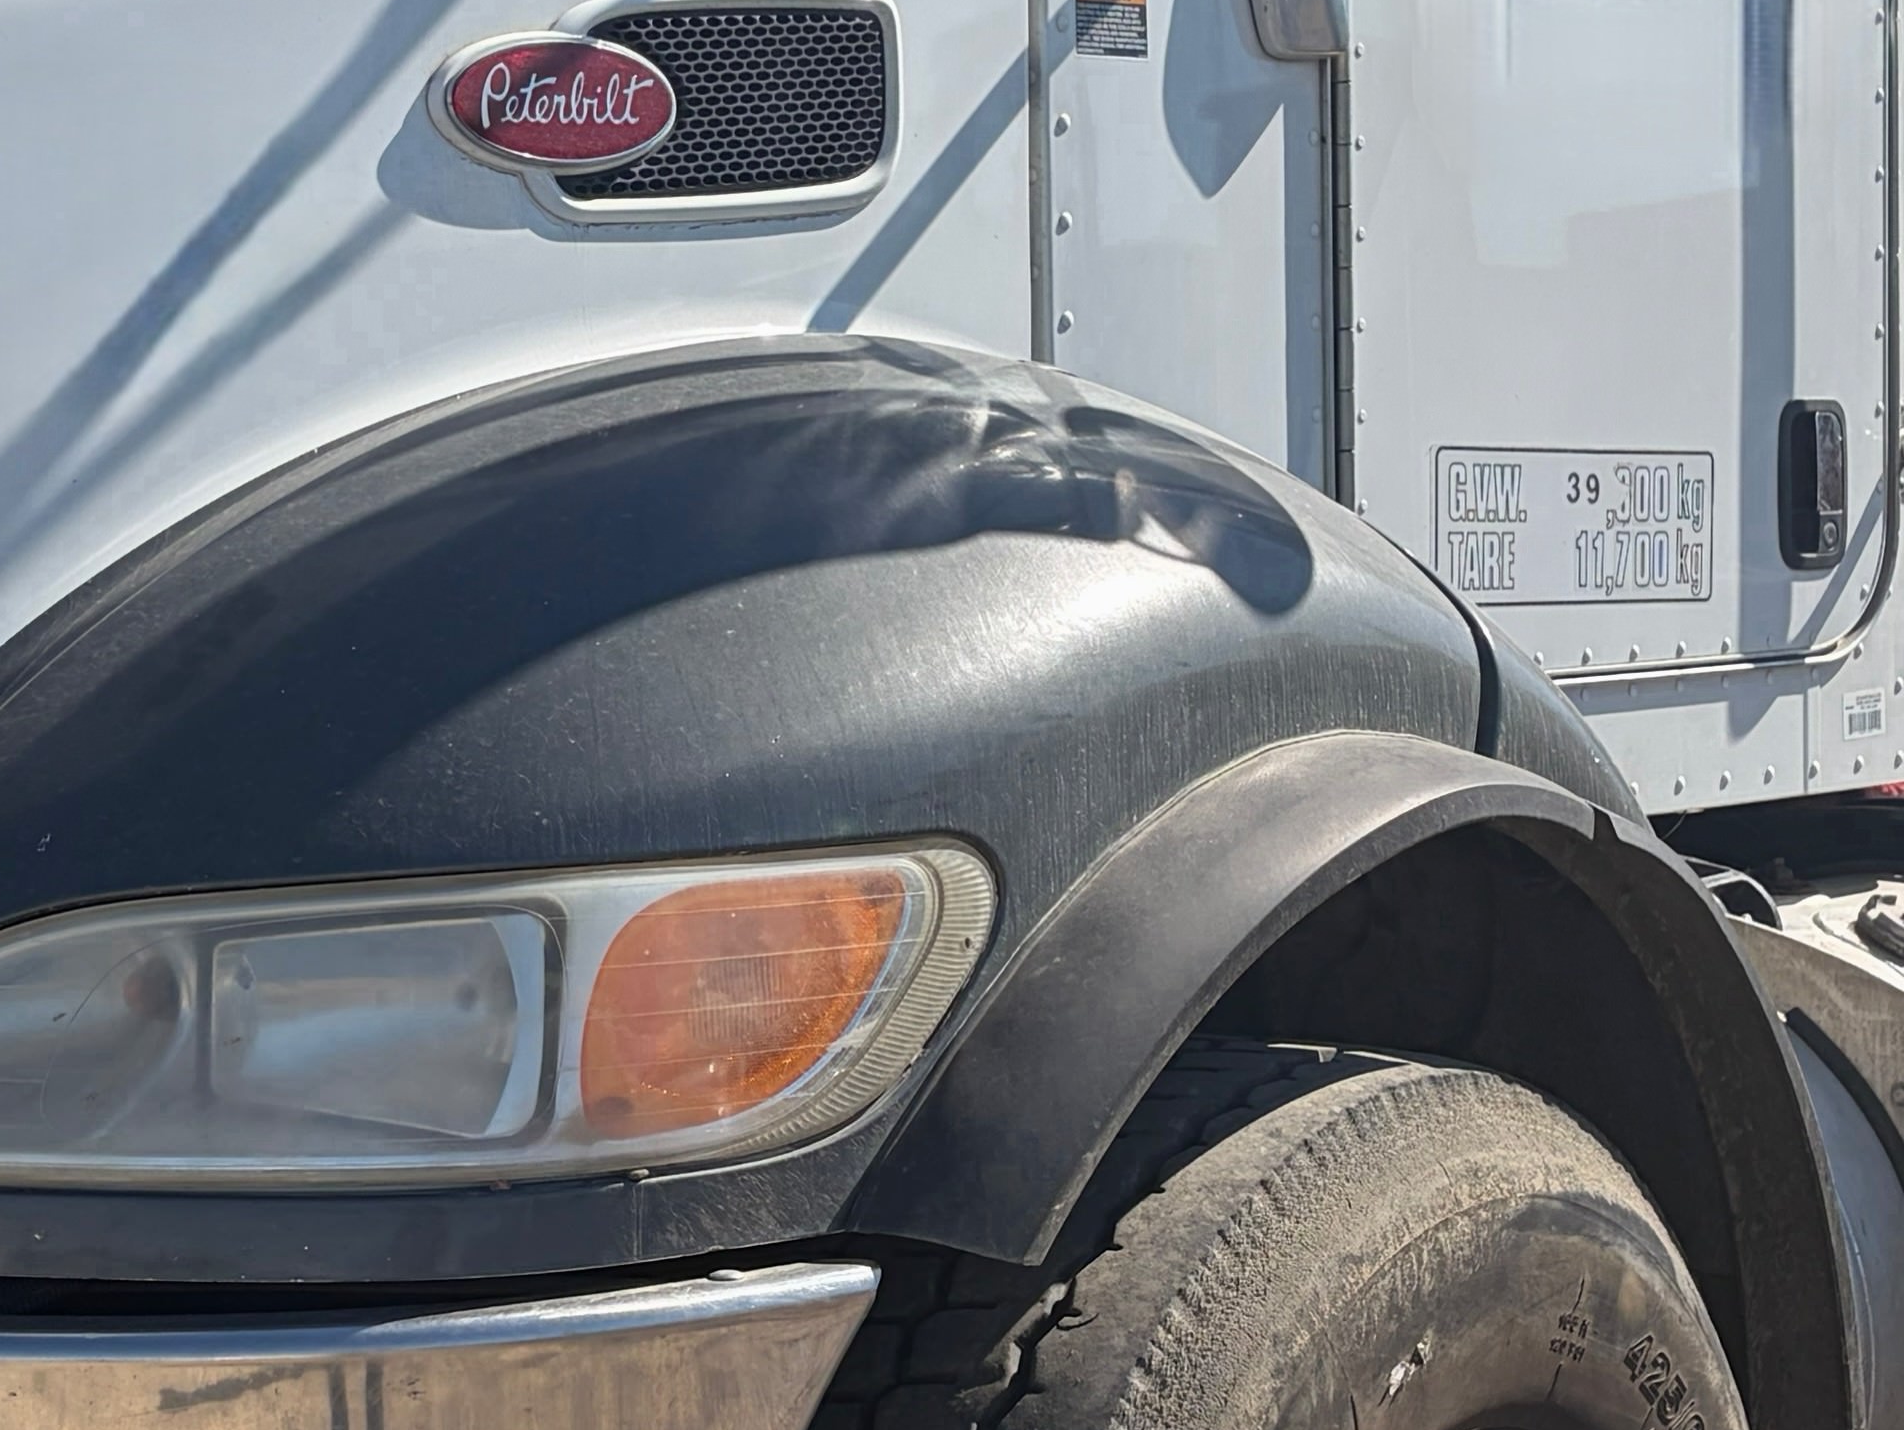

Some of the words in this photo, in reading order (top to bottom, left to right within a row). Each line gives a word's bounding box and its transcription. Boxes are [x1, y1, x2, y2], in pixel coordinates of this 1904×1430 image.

[481, 62, 654, 129] Peterbilt
[1448, 462, 1527, 522] G.V.W.
[1676, 462, 1704, 533] kg
[1448, 531, 1515, 591] TARE
[1575, 530, 1669, 596] 11,700
[1676, 528, 1703, 596] kg
